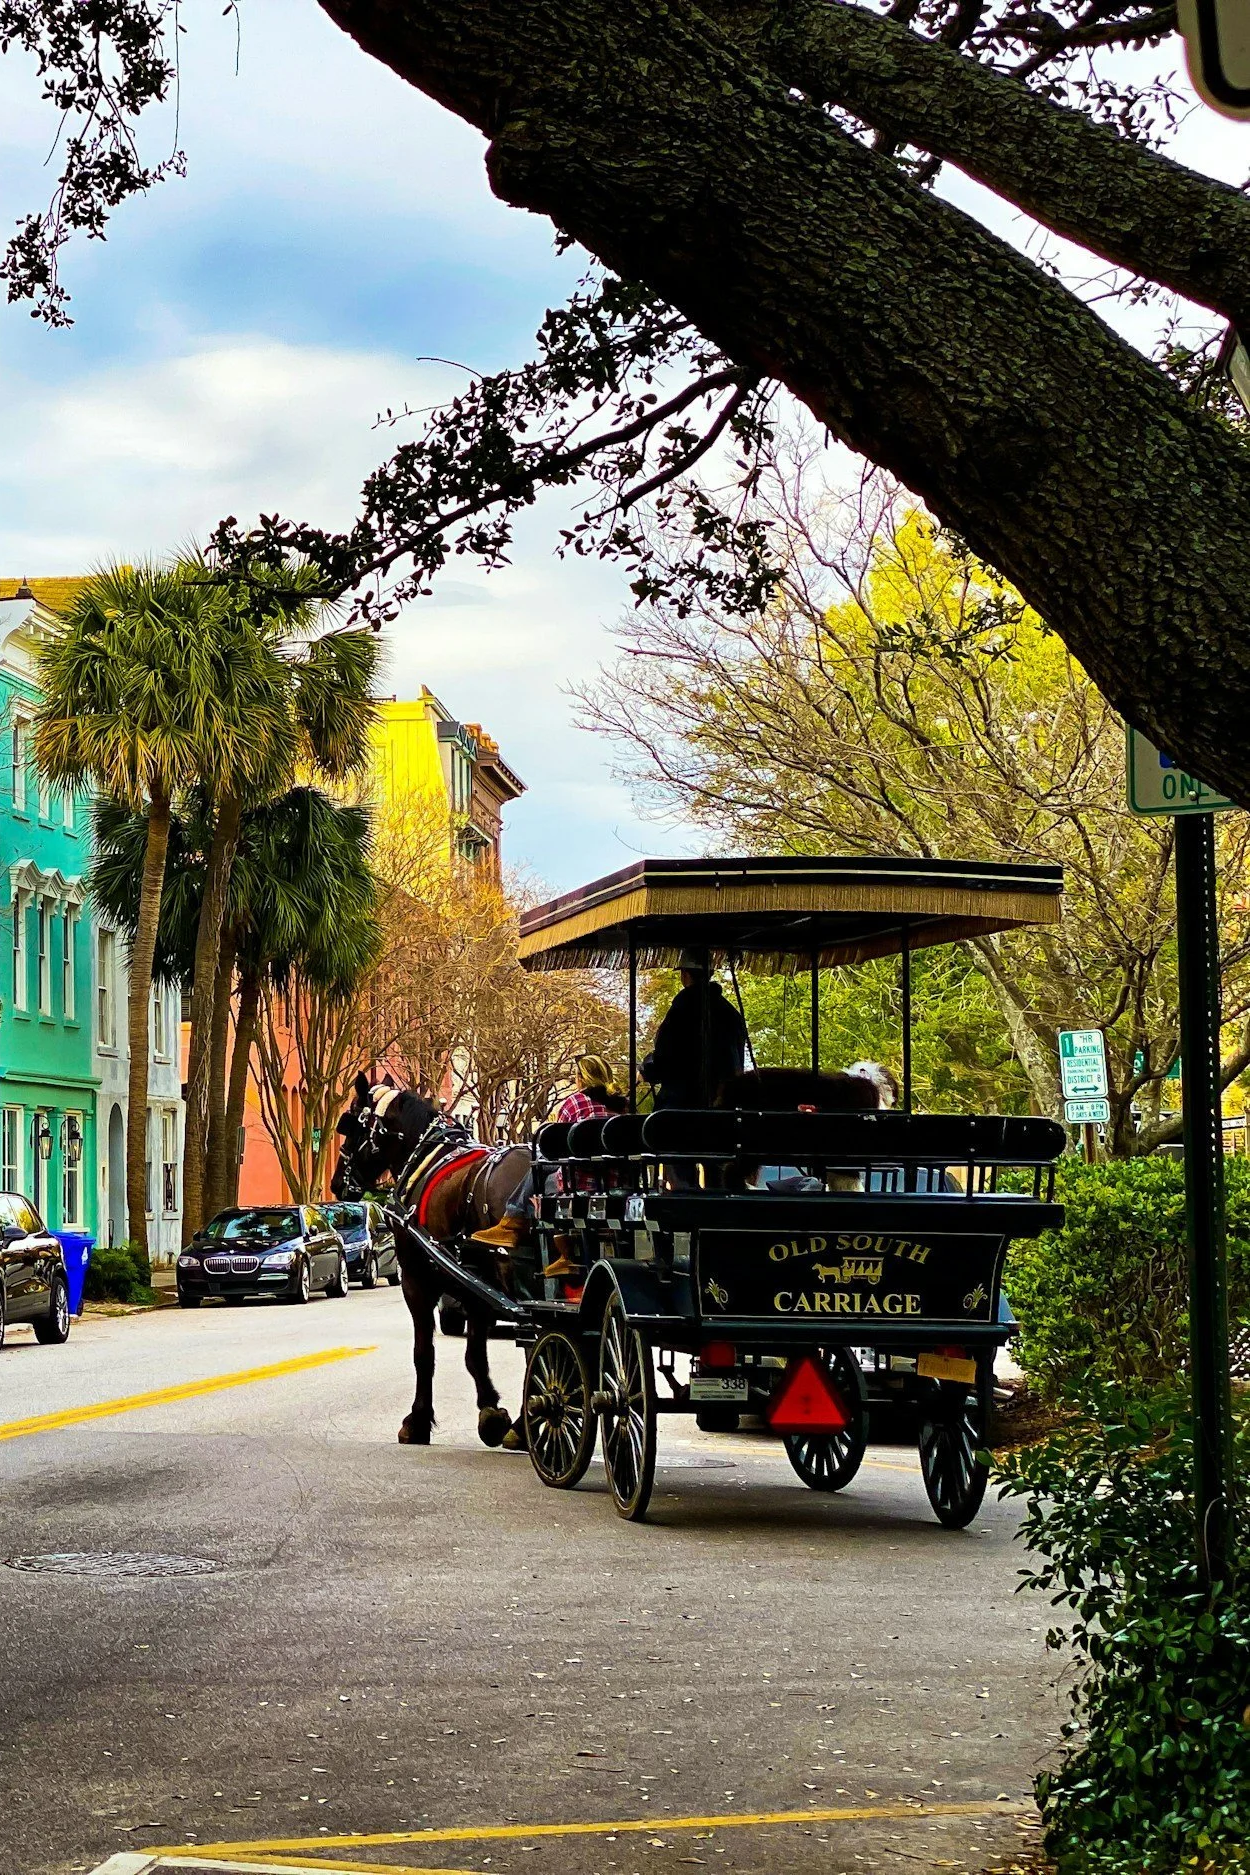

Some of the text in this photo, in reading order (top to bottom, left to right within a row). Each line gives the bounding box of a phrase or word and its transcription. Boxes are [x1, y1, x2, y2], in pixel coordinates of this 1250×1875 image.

[1162, 773, 1219, 800] ONL
[1064, 1034, 1093, 1054] 1 HR
[1074, 1045, 1101, 1054] PARKING
[1066, 1058, 1099, 1068] RESIDENTIAL
[1068, 1075, 1093, 1084] DISTRICT
[768, 1234, 932, 1265] OLD SOUTH
[773, 1290, 922, 1315] CARRIAGE
[721, 1377, 746, 1390] 338
